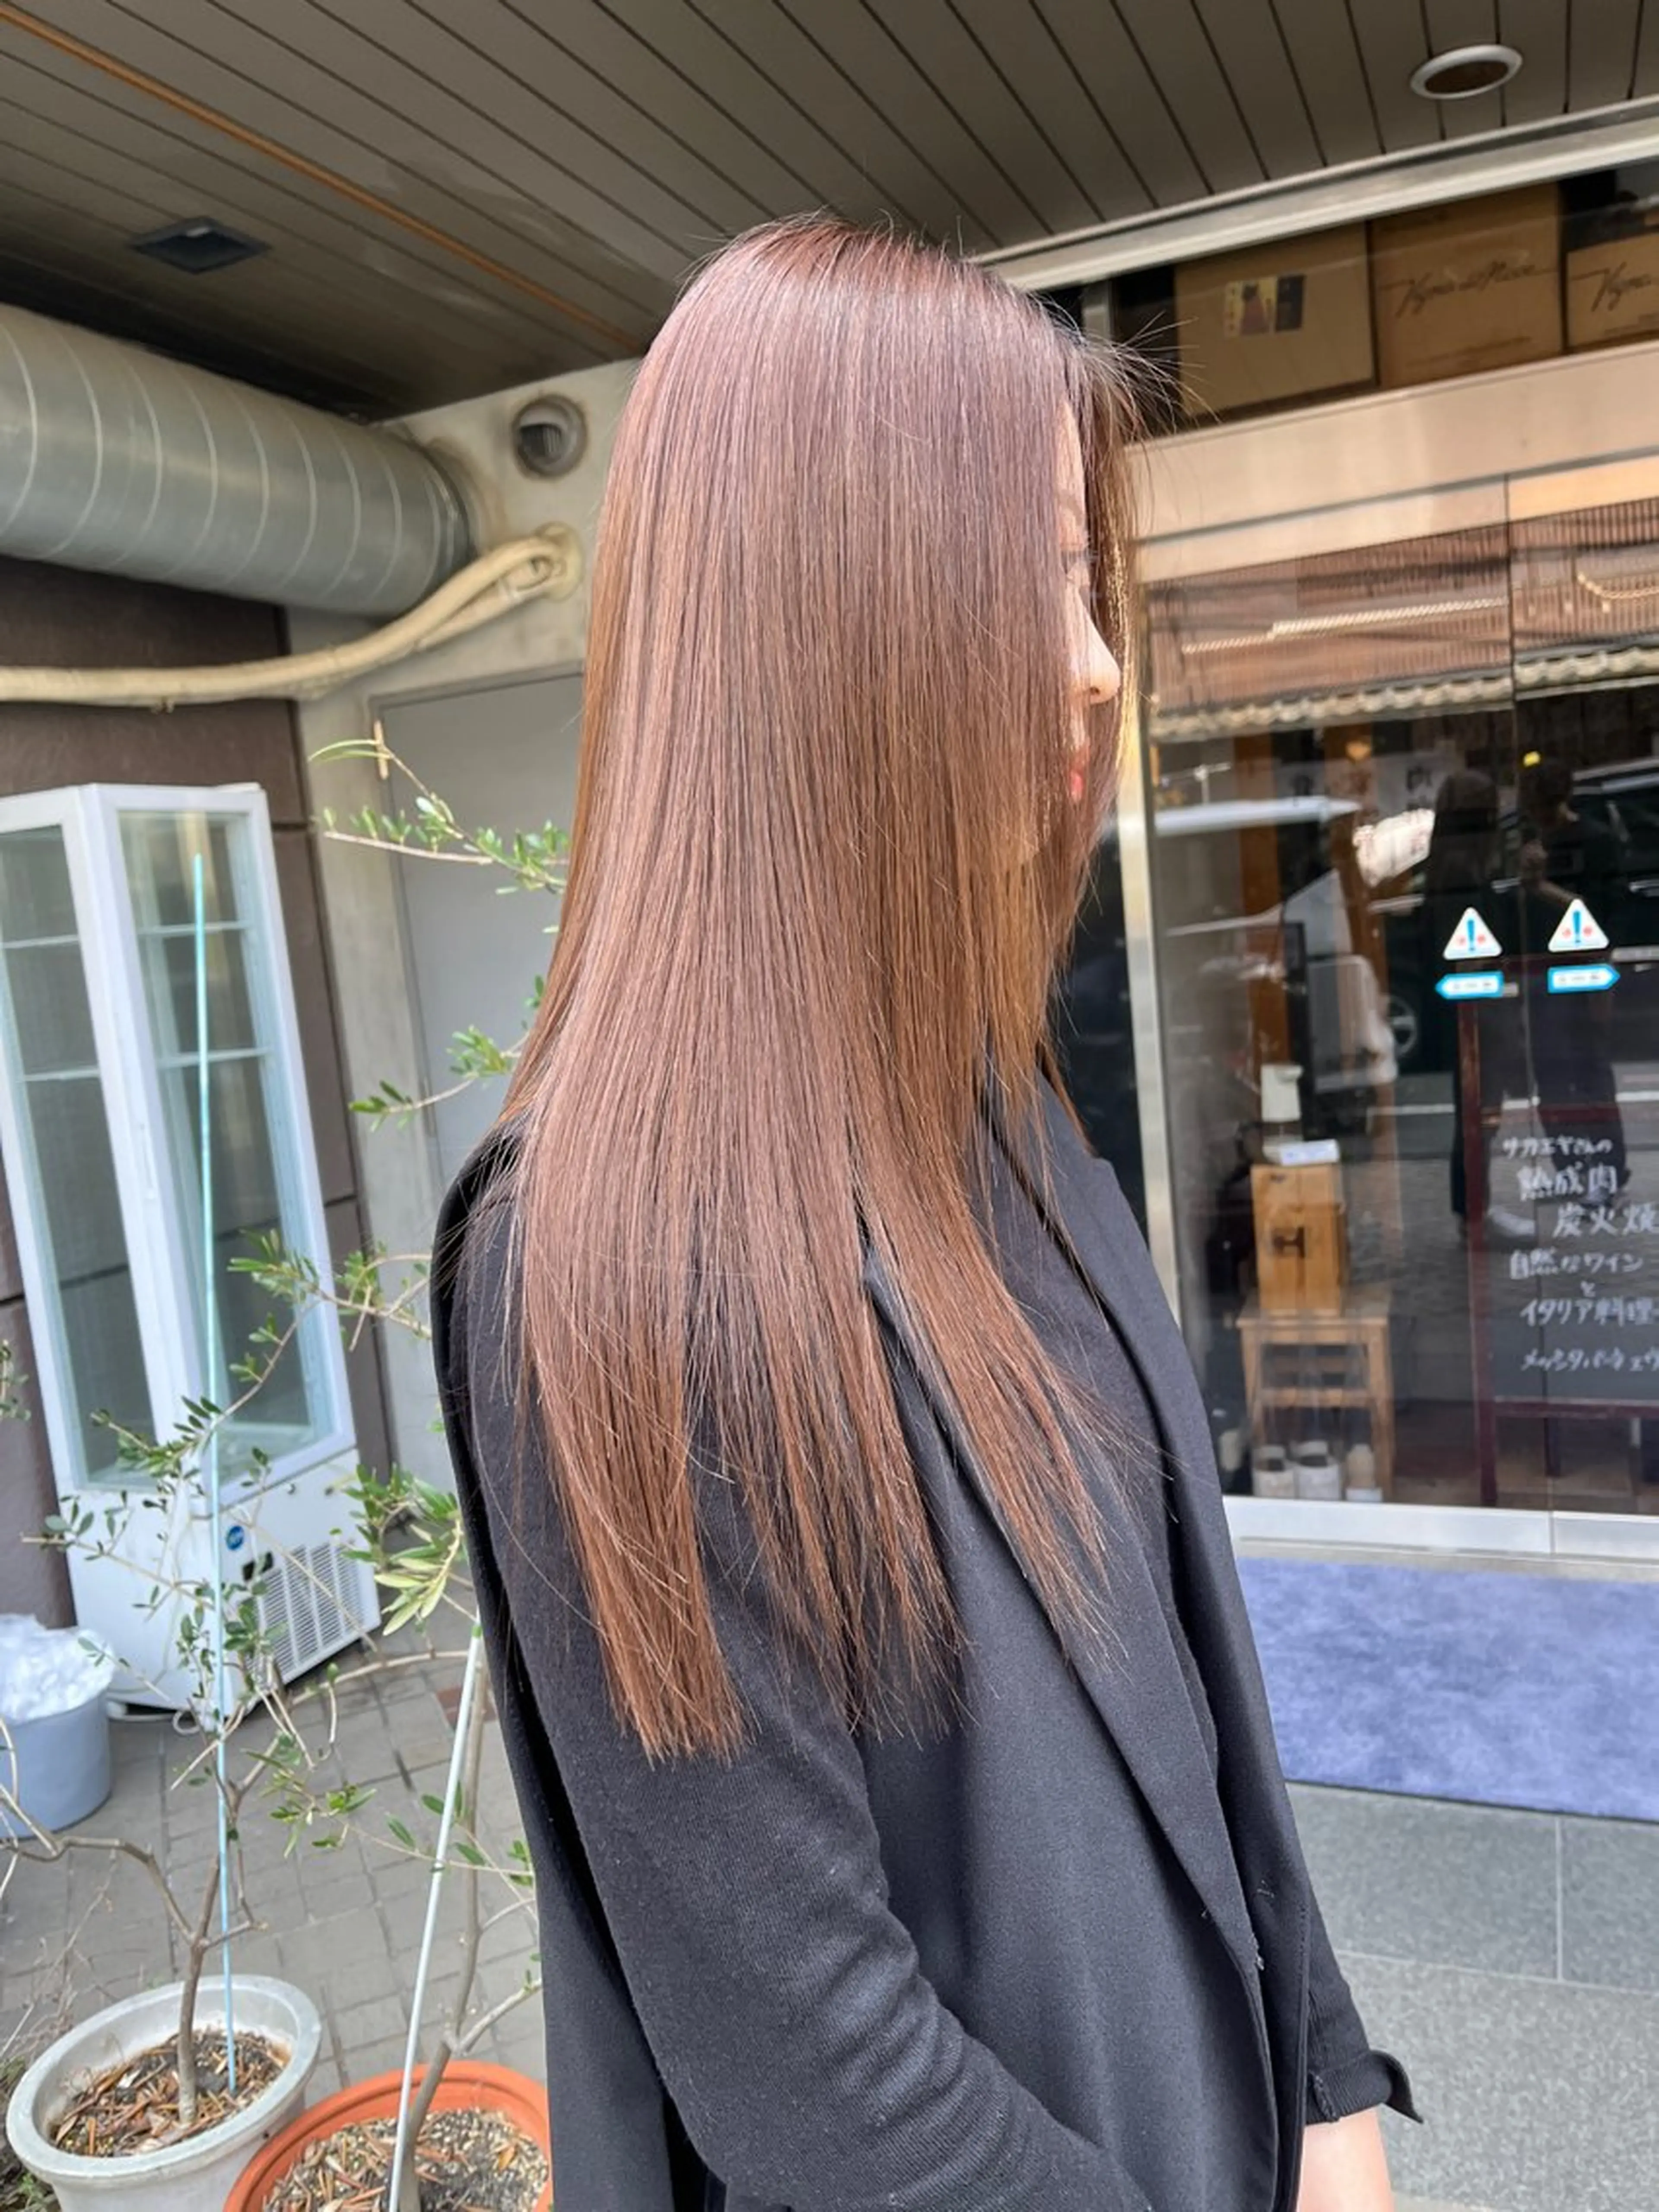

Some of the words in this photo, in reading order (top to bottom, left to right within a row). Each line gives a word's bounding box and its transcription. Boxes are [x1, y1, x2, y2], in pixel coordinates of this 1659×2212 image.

[1517, 1161, 1618, 1201] 熟成肉
[1510, 1246, 1643, 1280] 自然なワイン
[1580, 1281, 1596, 1297] と
[1519, 1296, 1659, 1326] イタリア料理
